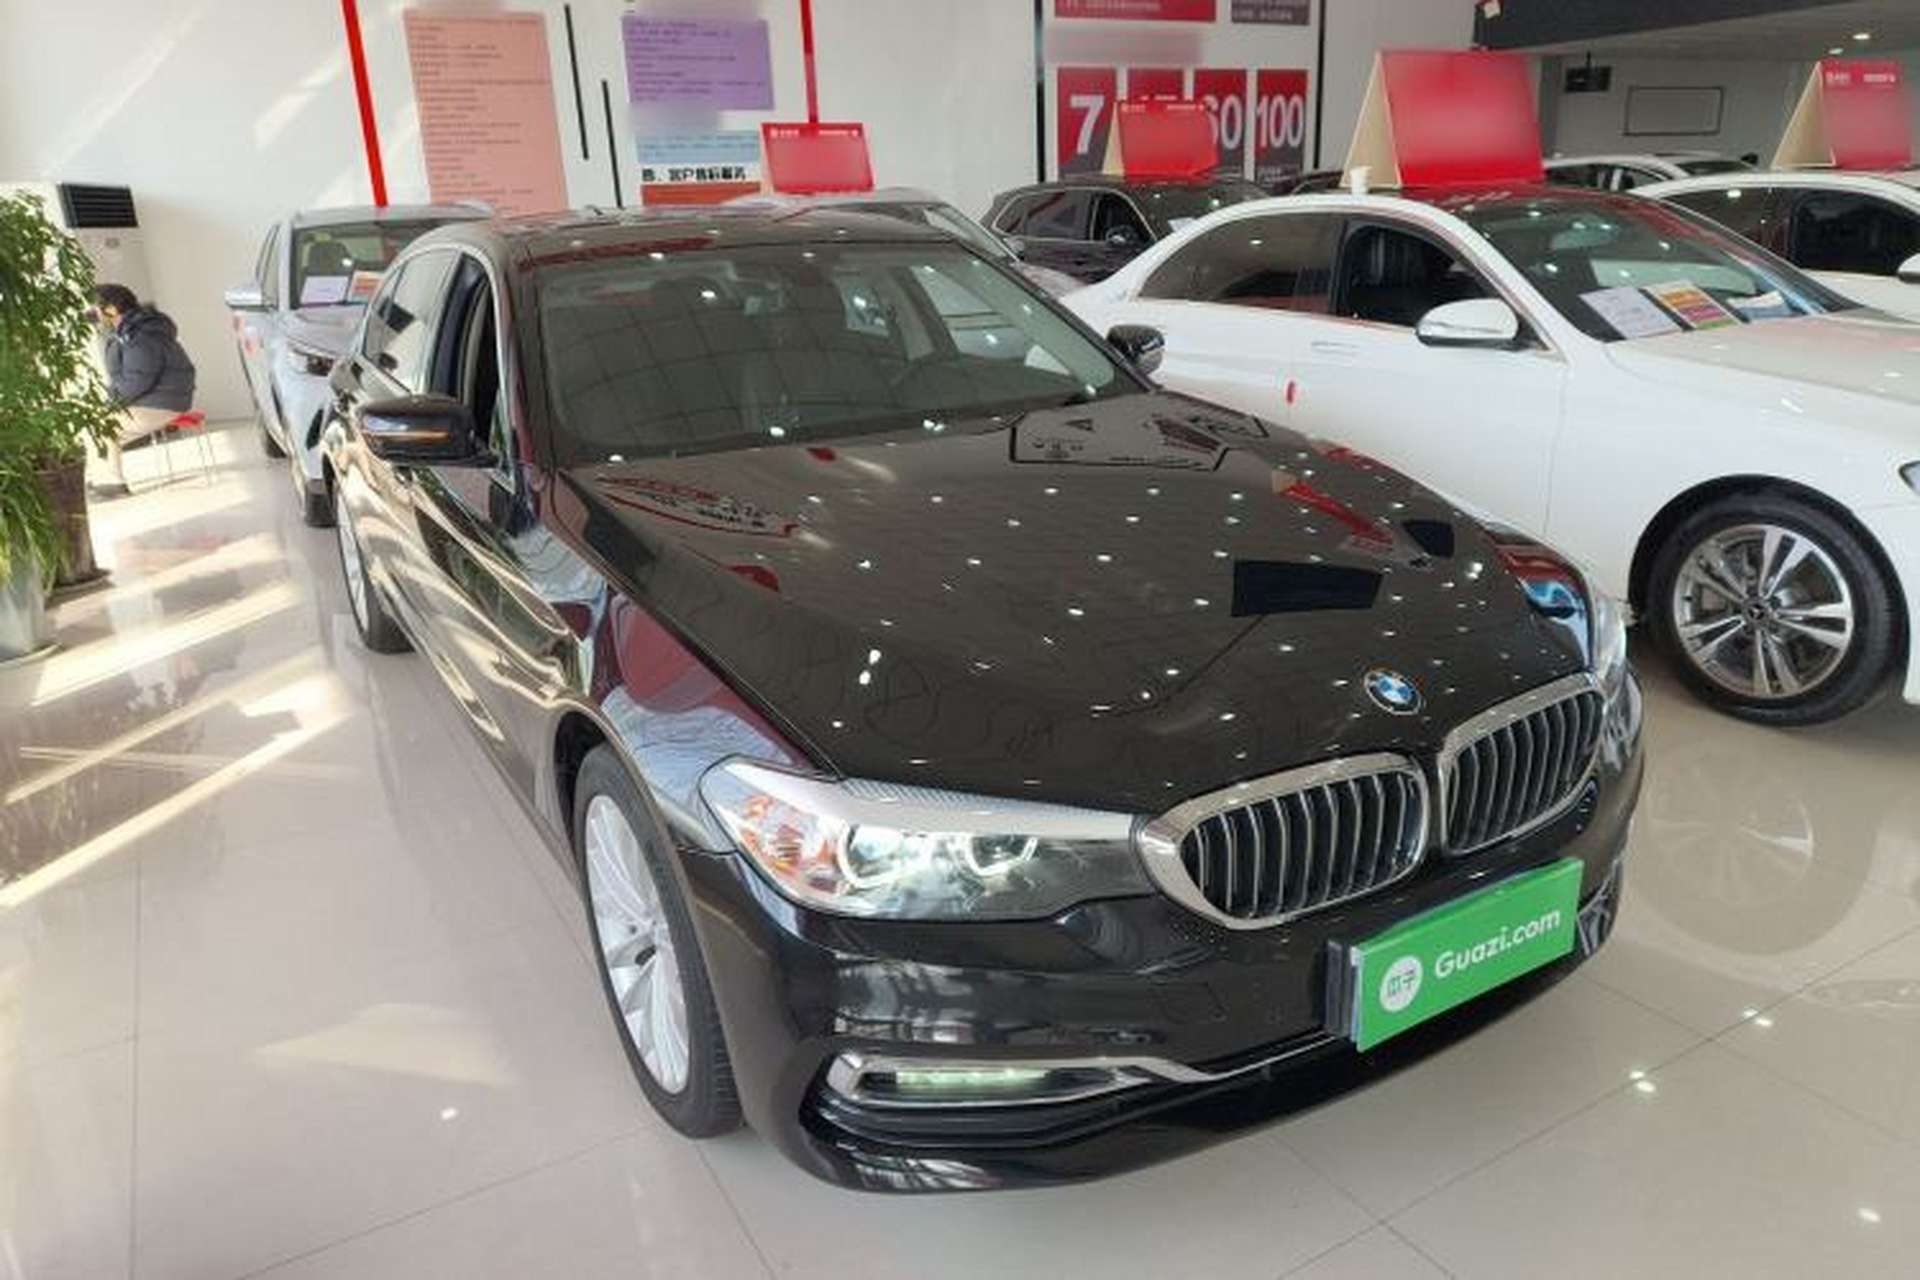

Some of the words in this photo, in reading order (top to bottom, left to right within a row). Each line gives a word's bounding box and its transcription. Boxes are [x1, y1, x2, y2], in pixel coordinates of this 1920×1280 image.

[1070, 94, 1104, 154] 7
[1257, 94, 1304, 149] 100
[1434, 910, 1561, 979] Guazi.com
